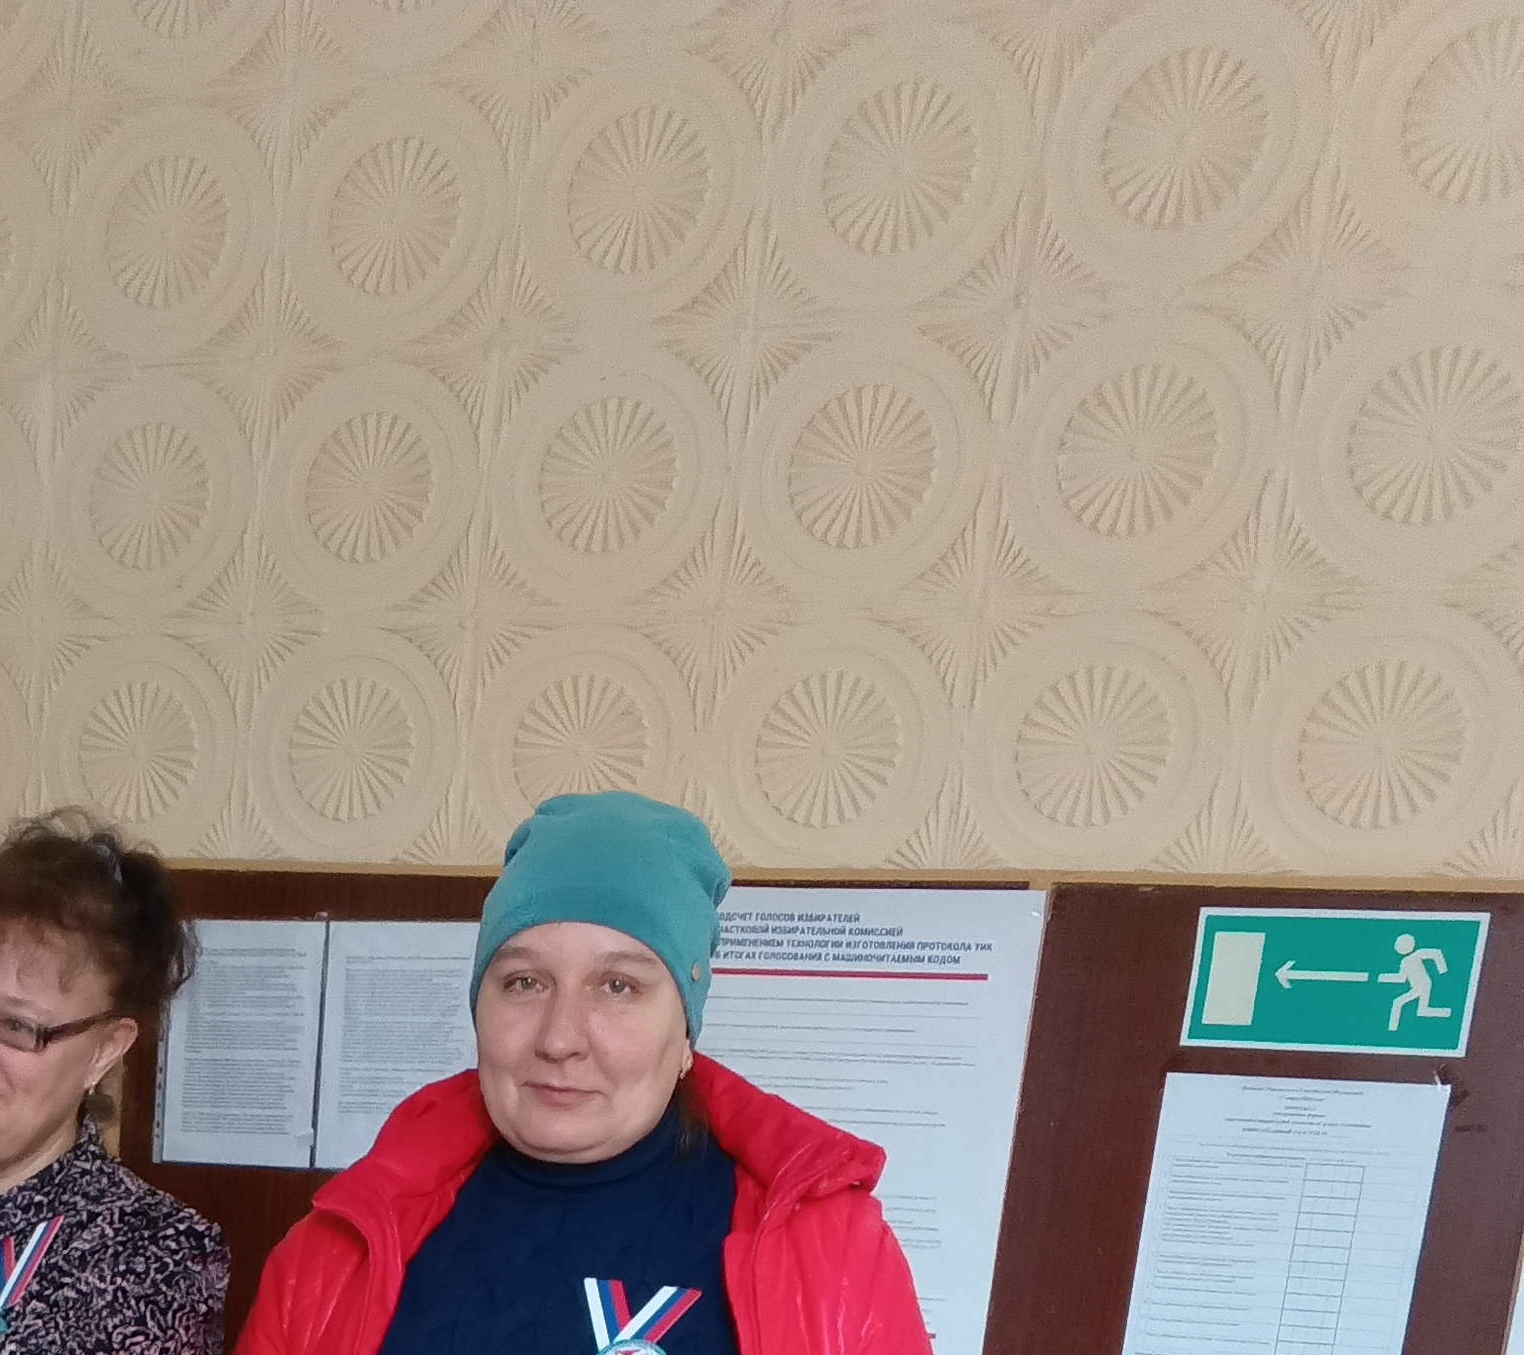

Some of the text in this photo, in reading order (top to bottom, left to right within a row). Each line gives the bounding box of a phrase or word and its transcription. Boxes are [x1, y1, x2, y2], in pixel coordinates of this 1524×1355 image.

[719, 911, 861, 923] ОДСЧЕТ ГОЛОСОВ ИЗБИРАТЕЛЕЙ
[719, 924, 904, 937] ЧАСТКОВОЙ ИЗБИРАТЕЛЬНОЙ КОМИССИЕЙ
[786, 939, 844, 949] ТЕХНОЛОГИИ
[845, 940, 915, 951] ИЗГОТОВЛЕНИЯ
[916, 941, 972, 952] ПРОТОКОЛА
[722, 950, 757, 961] ИТОГАХ
[758, 951, 823, 962] ГОЛОСОВАНИЯ
[927, 955, 962, 966] КОДОМ
